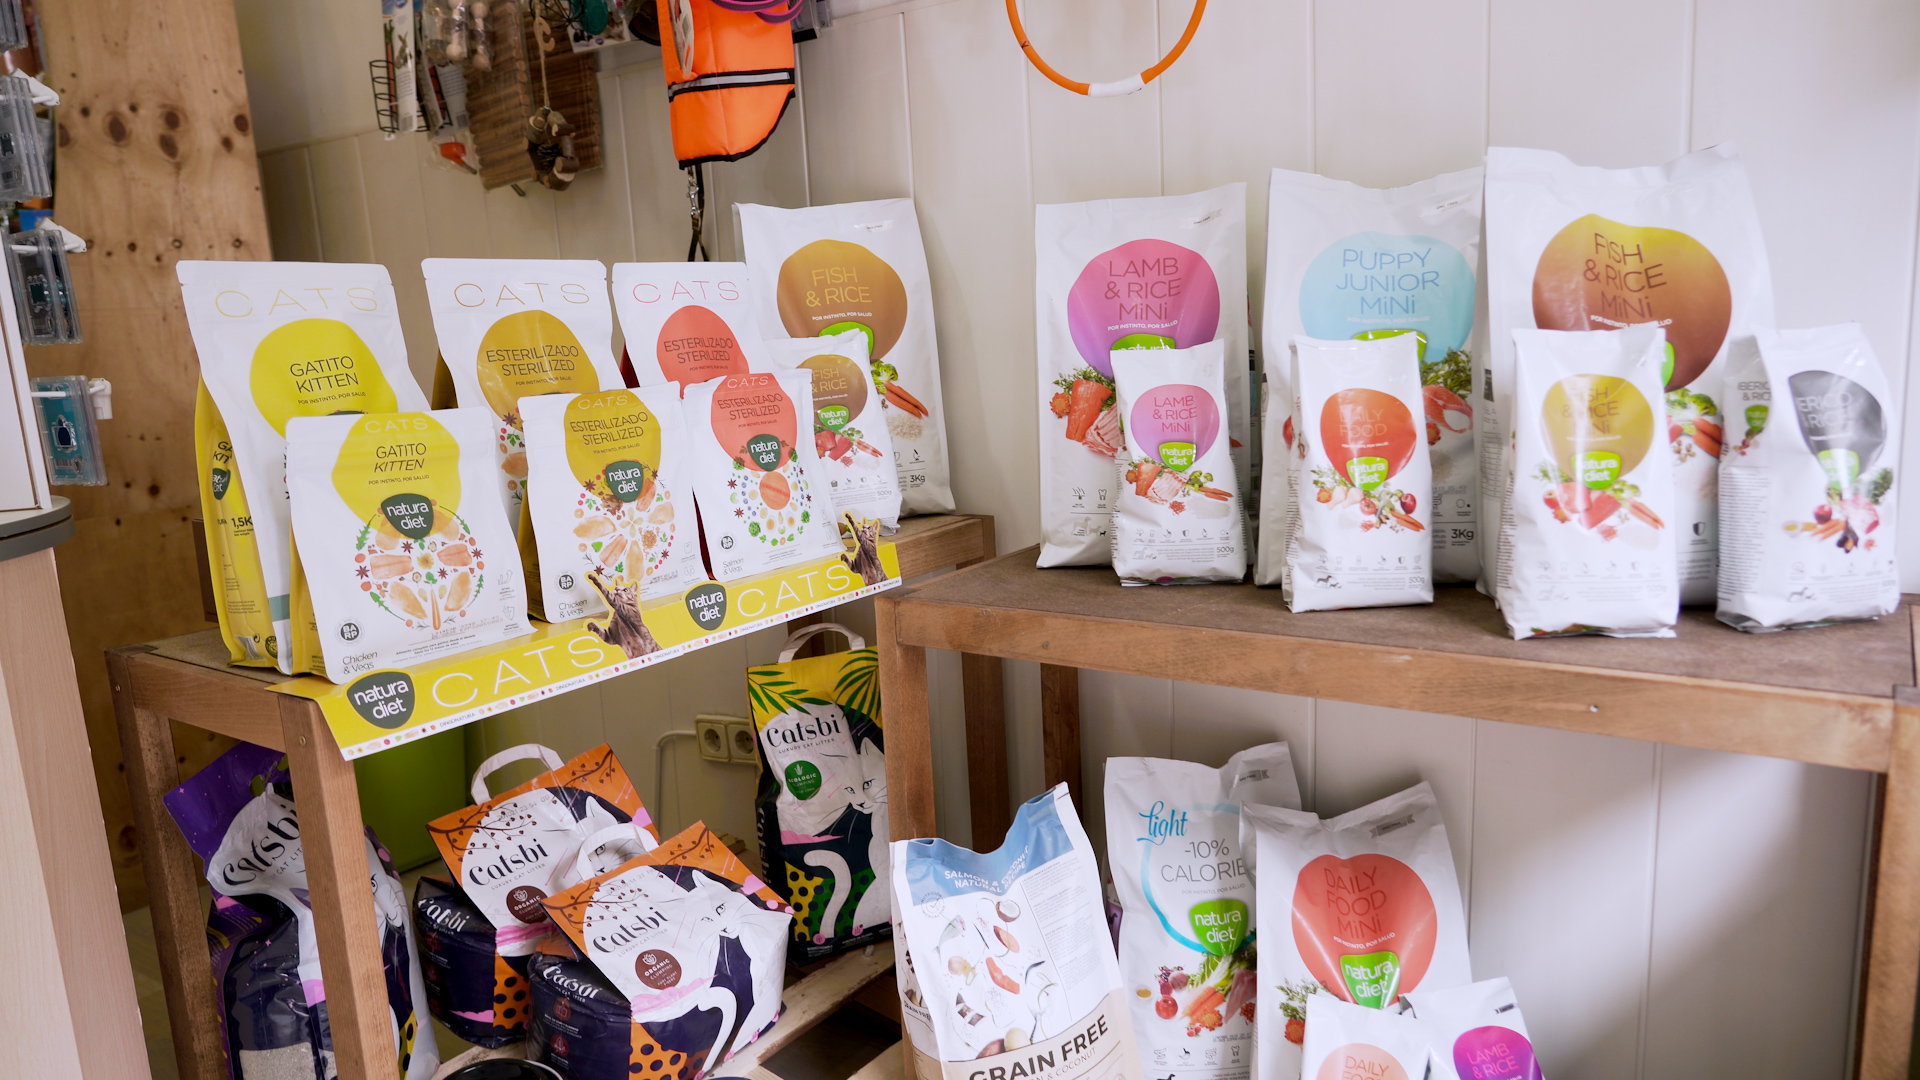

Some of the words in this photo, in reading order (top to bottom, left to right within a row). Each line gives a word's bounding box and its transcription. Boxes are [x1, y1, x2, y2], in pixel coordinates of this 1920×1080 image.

[1594, 232, 1644, 266] FISH
[1342, 248, 1432, 270] PUPPY
[1109, 257, 1178, 278] LAMB
[1584, 258, 1602, 284] &
[1605, 264, 1668, 293] RICE
[812, 266, 858, 286] FISH
[1336, 270, 1440, 292] JUNIOR
[454, 282, 590, 308] CATS
[633, 280, 740, 304] CATS
[806, 290, 821, 307] &
[825, 286, 872, 305] RICE
[1104, 281, 1120, 300] &
[1128, 278, 1182, 299] RICE
[215, 287, 378, 318] CATS
[1360, 295, 1416, 315] MiNi
[1600, 291, 1653, 320] MiNi
[1118, 302, 1168, 320] MiNi
[664, 338, 734, 352] ESTERILIZADO
[486, 345, 579, 363] ESTERILIZADO
[677, 350, 730, 364] STERILIZED
[290, 356, 354, 377] GATITO
[502, 359, 576, 377] STERILIZED
[814, 368, 840, 380] FISH
[296, 372, 359, 394] KITTEN
[727, 376, 769, 388] CATS
[820, 378, 848, 392] RICE
[578, 395, 628, 410] CATS
[718, 393, 784, 409] ESTERILIZADO
[1154, 396, 1194, 408] LAMB
[729, 404, 780, 420] STERILIZED
[820, 410, 846, 418] natura
[1152, 410, 1162, 420] &
[1166, 407, 1198, 420] RICE
[365, 418, 428, 433] CATS
[570, 412, 648, 432] ESTERILIZADO
[828, 417, 844, 426] diet
[1162, 422, 1190, 432] MiNi
[582, 426, 644, 446] STERILIZED
[1340, 424, 1387, 438] FOOD
[376, 442, 426, 458] GATITO
[750, 440, 778, 453] natura
[1162, 448, 1194, 456] natura
[374, 458, 424, 473] KITTEN
[760, 452, 776, 464] diet
[1168, 456, 1188, 466] diet
[608, 468, 641, 482] natura
[910, 474, 926, 483] 3Kg
[618, 481, 638, 494] diet
[386, 501, 429, 516] natura
[400, 515, 426, 530] diet
[1451, 528, 1474, 540] 3Kg
[1216, 546, 1234, 554] 500g
[722, 558, 744, 568] Salmon
[730, 564, 743, 575] Vegs
[1408, 576, 1424, 586] 500g
[737, 564, 851, 618] CATS
[558, 600, 588, 610] Chicken
[689, 592, 724, 610] natura
[566, 607, 584, 616] Vegs
[699, 606, 722, 622] diet
[343, 624, 356, 632] BA
[344, 631, 358, 639] RP
[342, 651, 378, 666] Chicken
[344, 666, 350, 674] &
[352, 661, 374, 672] Vegs
[432, 636, 604, 708] CATS
[354, 679, 409, 706] natura
[372, 698, 407, 720] diet
[766, 714, 841, 748] Catsbi
[778, 746, 800, 754] LUXURY
[816, 738, 835, 746] LITTER
[1136, 800, 1188, 846] light
[1184, 838, 1230, 859] -10%
[276, 863, 290, 876] CAT
[469, 838, 550, 886] Catsbi
[491, 880, 512, 890] LUXURY
[526, 862, 546, 874] LITTER
[944, 870, 988, 886] SALMON
[1324, 866, 1377, 895] DAILY
[954, 879, 1002, 893] NATURAL
[1229, 882, 1246, 892] SALUD
[514, 896, 540, 911] ORGANIC
[1326, 890, 1386, 916] FOOD
[1194, 909, 1242, 926] natura
[593, 906, 670, 954] Catsbi
[1206, 926, 1236, 943] diet
[1337, 914, 1382, 940] MiNi
[618, 945, 638, 958] LUXURY
[640, 939, 650, 948] CAT
[651, 928, 668, 940] LITTER
[1366, 940, 1378, 948] POR
[1378, 932, 1396, 944] SALUD
[644, 958, 670, 976] ORGANIC
[1345, 960, 1394, 980] natura
[1354, 979, 1388, 998] diet
[1061, 1014, 1110, 1062] FREE
[1466, 1043, 1510, 1064] LAMB
[1056, 1047, 1097, 1077] COCONUT
[1345, 1056, 1390, 1077] DAILY
[1472, 1066, 1484, 1080] &
[1482, 1056, 1520, 1078] RICE
